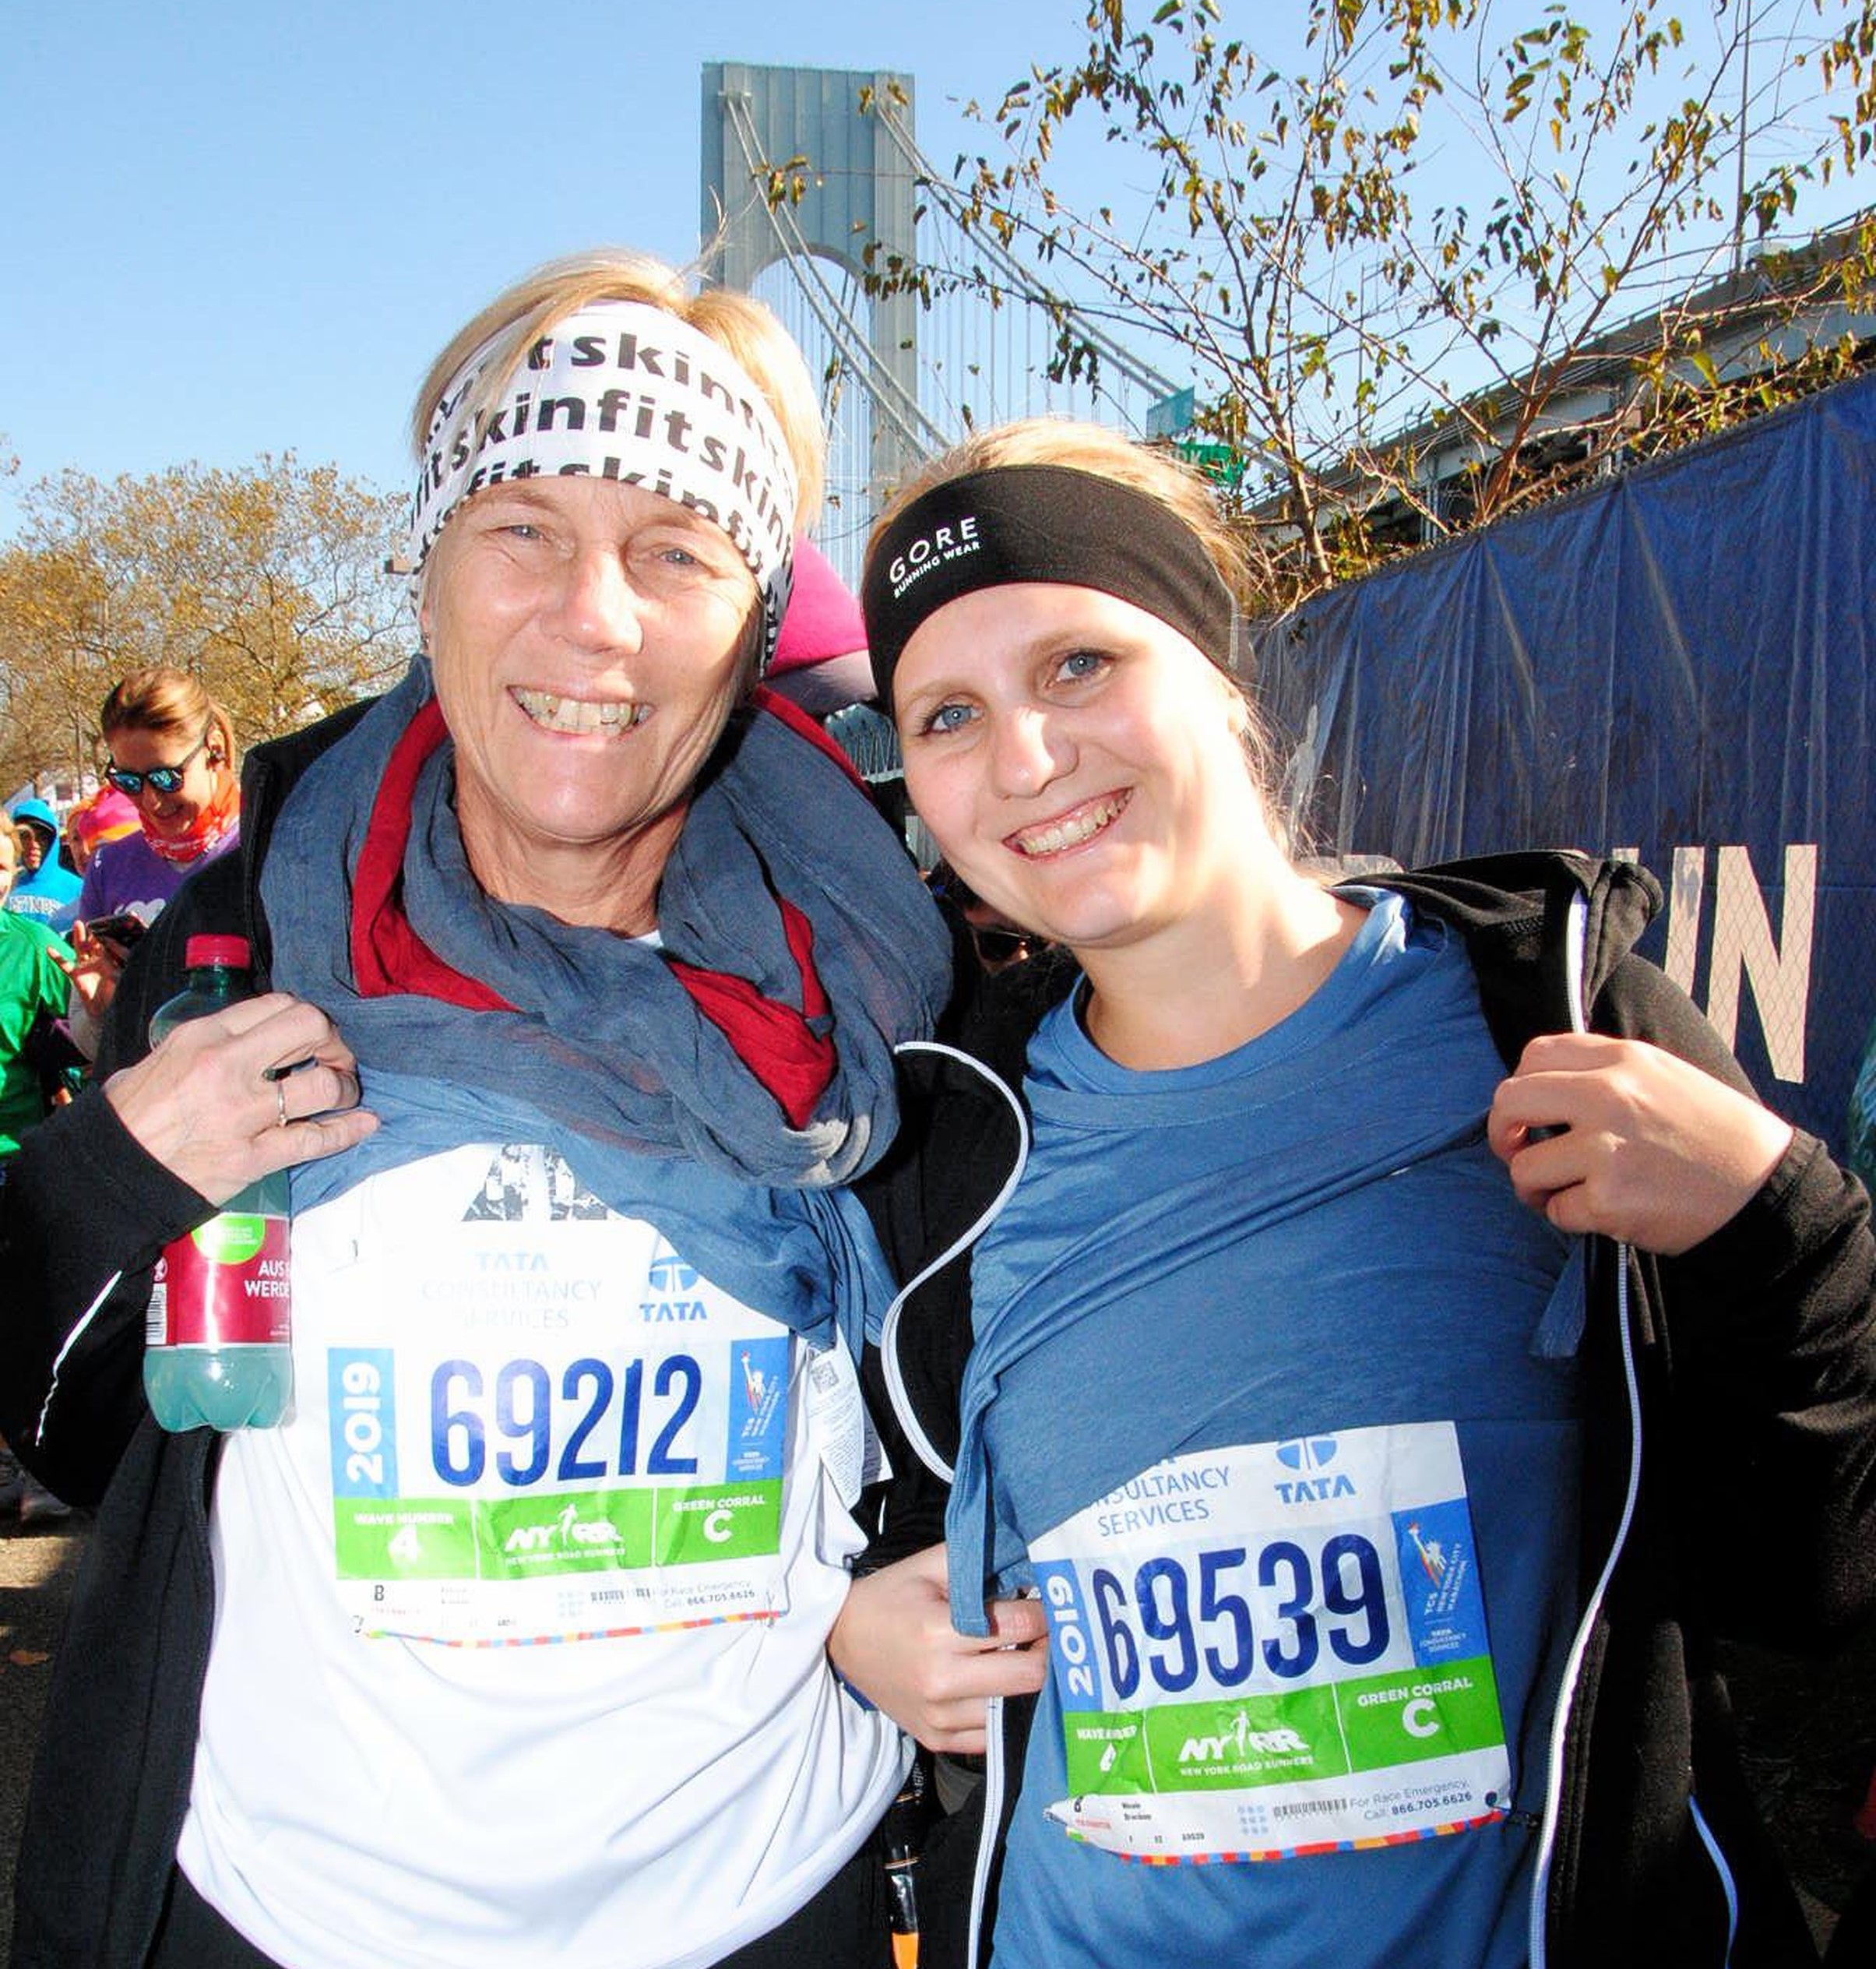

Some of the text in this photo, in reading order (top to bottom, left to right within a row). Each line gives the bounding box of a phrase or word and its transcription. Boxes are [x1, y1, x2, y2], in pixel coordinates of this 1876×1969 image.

[889, 516, 979, 583] GORE
[894, 541, 980, 599] RUNNING WEAR
[475, 1251, 550, 1272] TATA
[455, 1308, 569, 1330] ERVICES
[639, 1301, 709, 1323] TATA
[342, 1361, 383, 1485] 2019
[431, 1354, 702, 1488] 69212
[673, 1495, 766, 1512] GREEN CORRAL
[1274, 1474, 1358, 1505] TATA
[703, 1509, 734, 1543] C
[1097, 1499, 1210, 1537] SERVICES
[374, 1584, 385, 1601] B
[1092, 1534, 1391, 1700] 69539
[1046, 1574, 1094, 1698] 2019
[1357, 1676, 1473, 1707] GREEN CORRAL
[1403, 1697, 1440, 1738] C
[1180, 1766, 1202, 1777] NEW
[1203, 1765, 1230, 1776] YORK
[1373, 1791, 1403, 1805] Race
